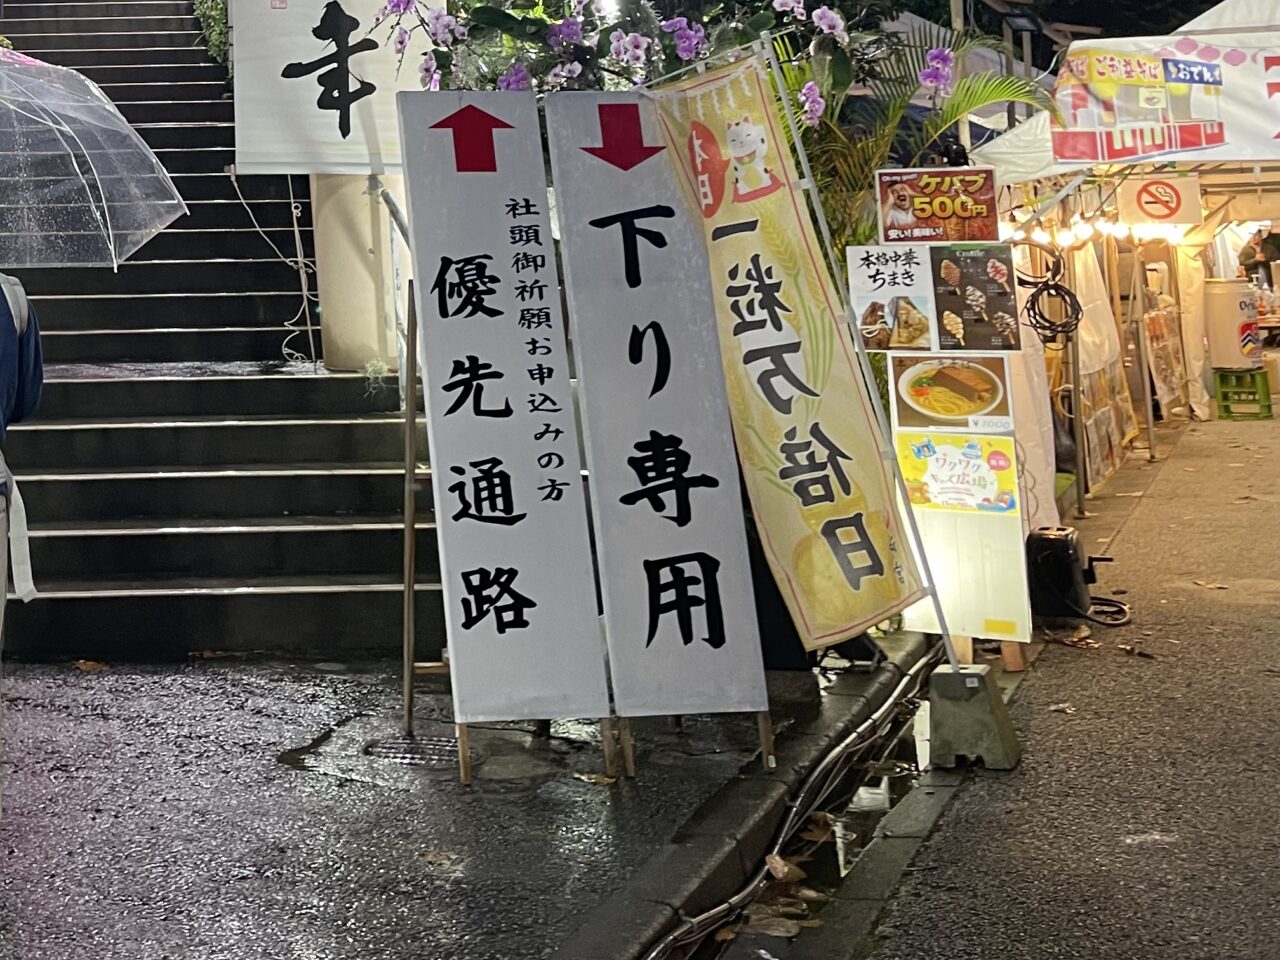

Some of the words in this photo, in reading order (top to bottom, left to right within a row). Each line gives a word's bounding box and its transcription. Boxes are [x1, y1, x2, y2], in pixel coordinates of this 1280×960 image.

[918, 173, 986, 195] ケバブ
[913, 196, 988, 219] 500円
[858, 248, 922, 270] 本格中華
[867, 269, 916, 293] ちまき
[504, 198, 570, 503] 社頭御祈願お申込みの方
[588, 204, 727, 649] 下り専用
[430, 253, 538, 635] 優先通路
